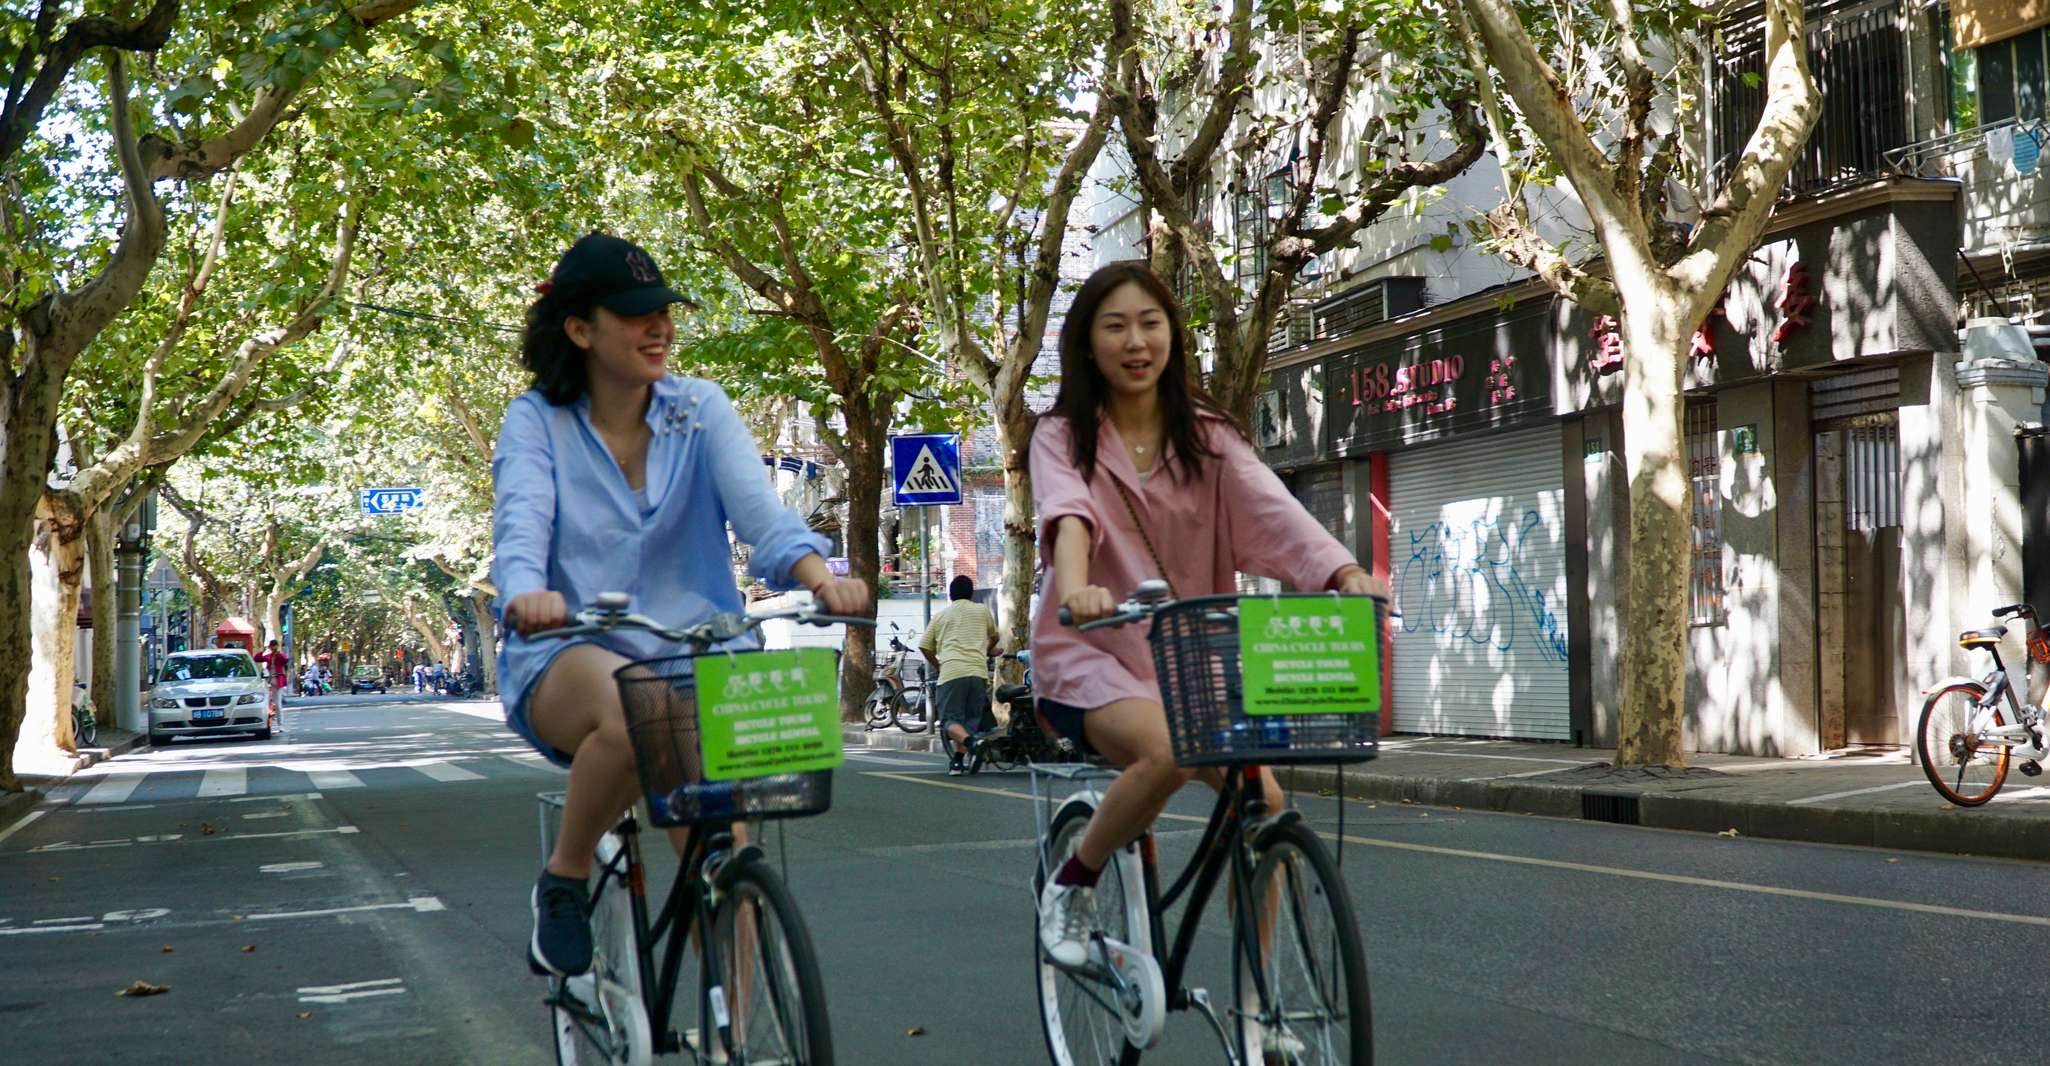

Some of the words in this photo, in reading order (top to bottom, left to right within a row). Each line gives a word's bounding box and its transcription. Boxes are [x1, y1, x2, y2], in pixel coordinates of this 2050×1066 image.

[1253, 643, 1288, 653] CHINA
[1289, 643, 1326, 653] CYCLE
[1330, 642, 1365, 653] TOURS
[712, 703, 750, 715] CHINA
[751, 698, 787, 710] CYCLE
[793, 693, 828, 705] TOURS
